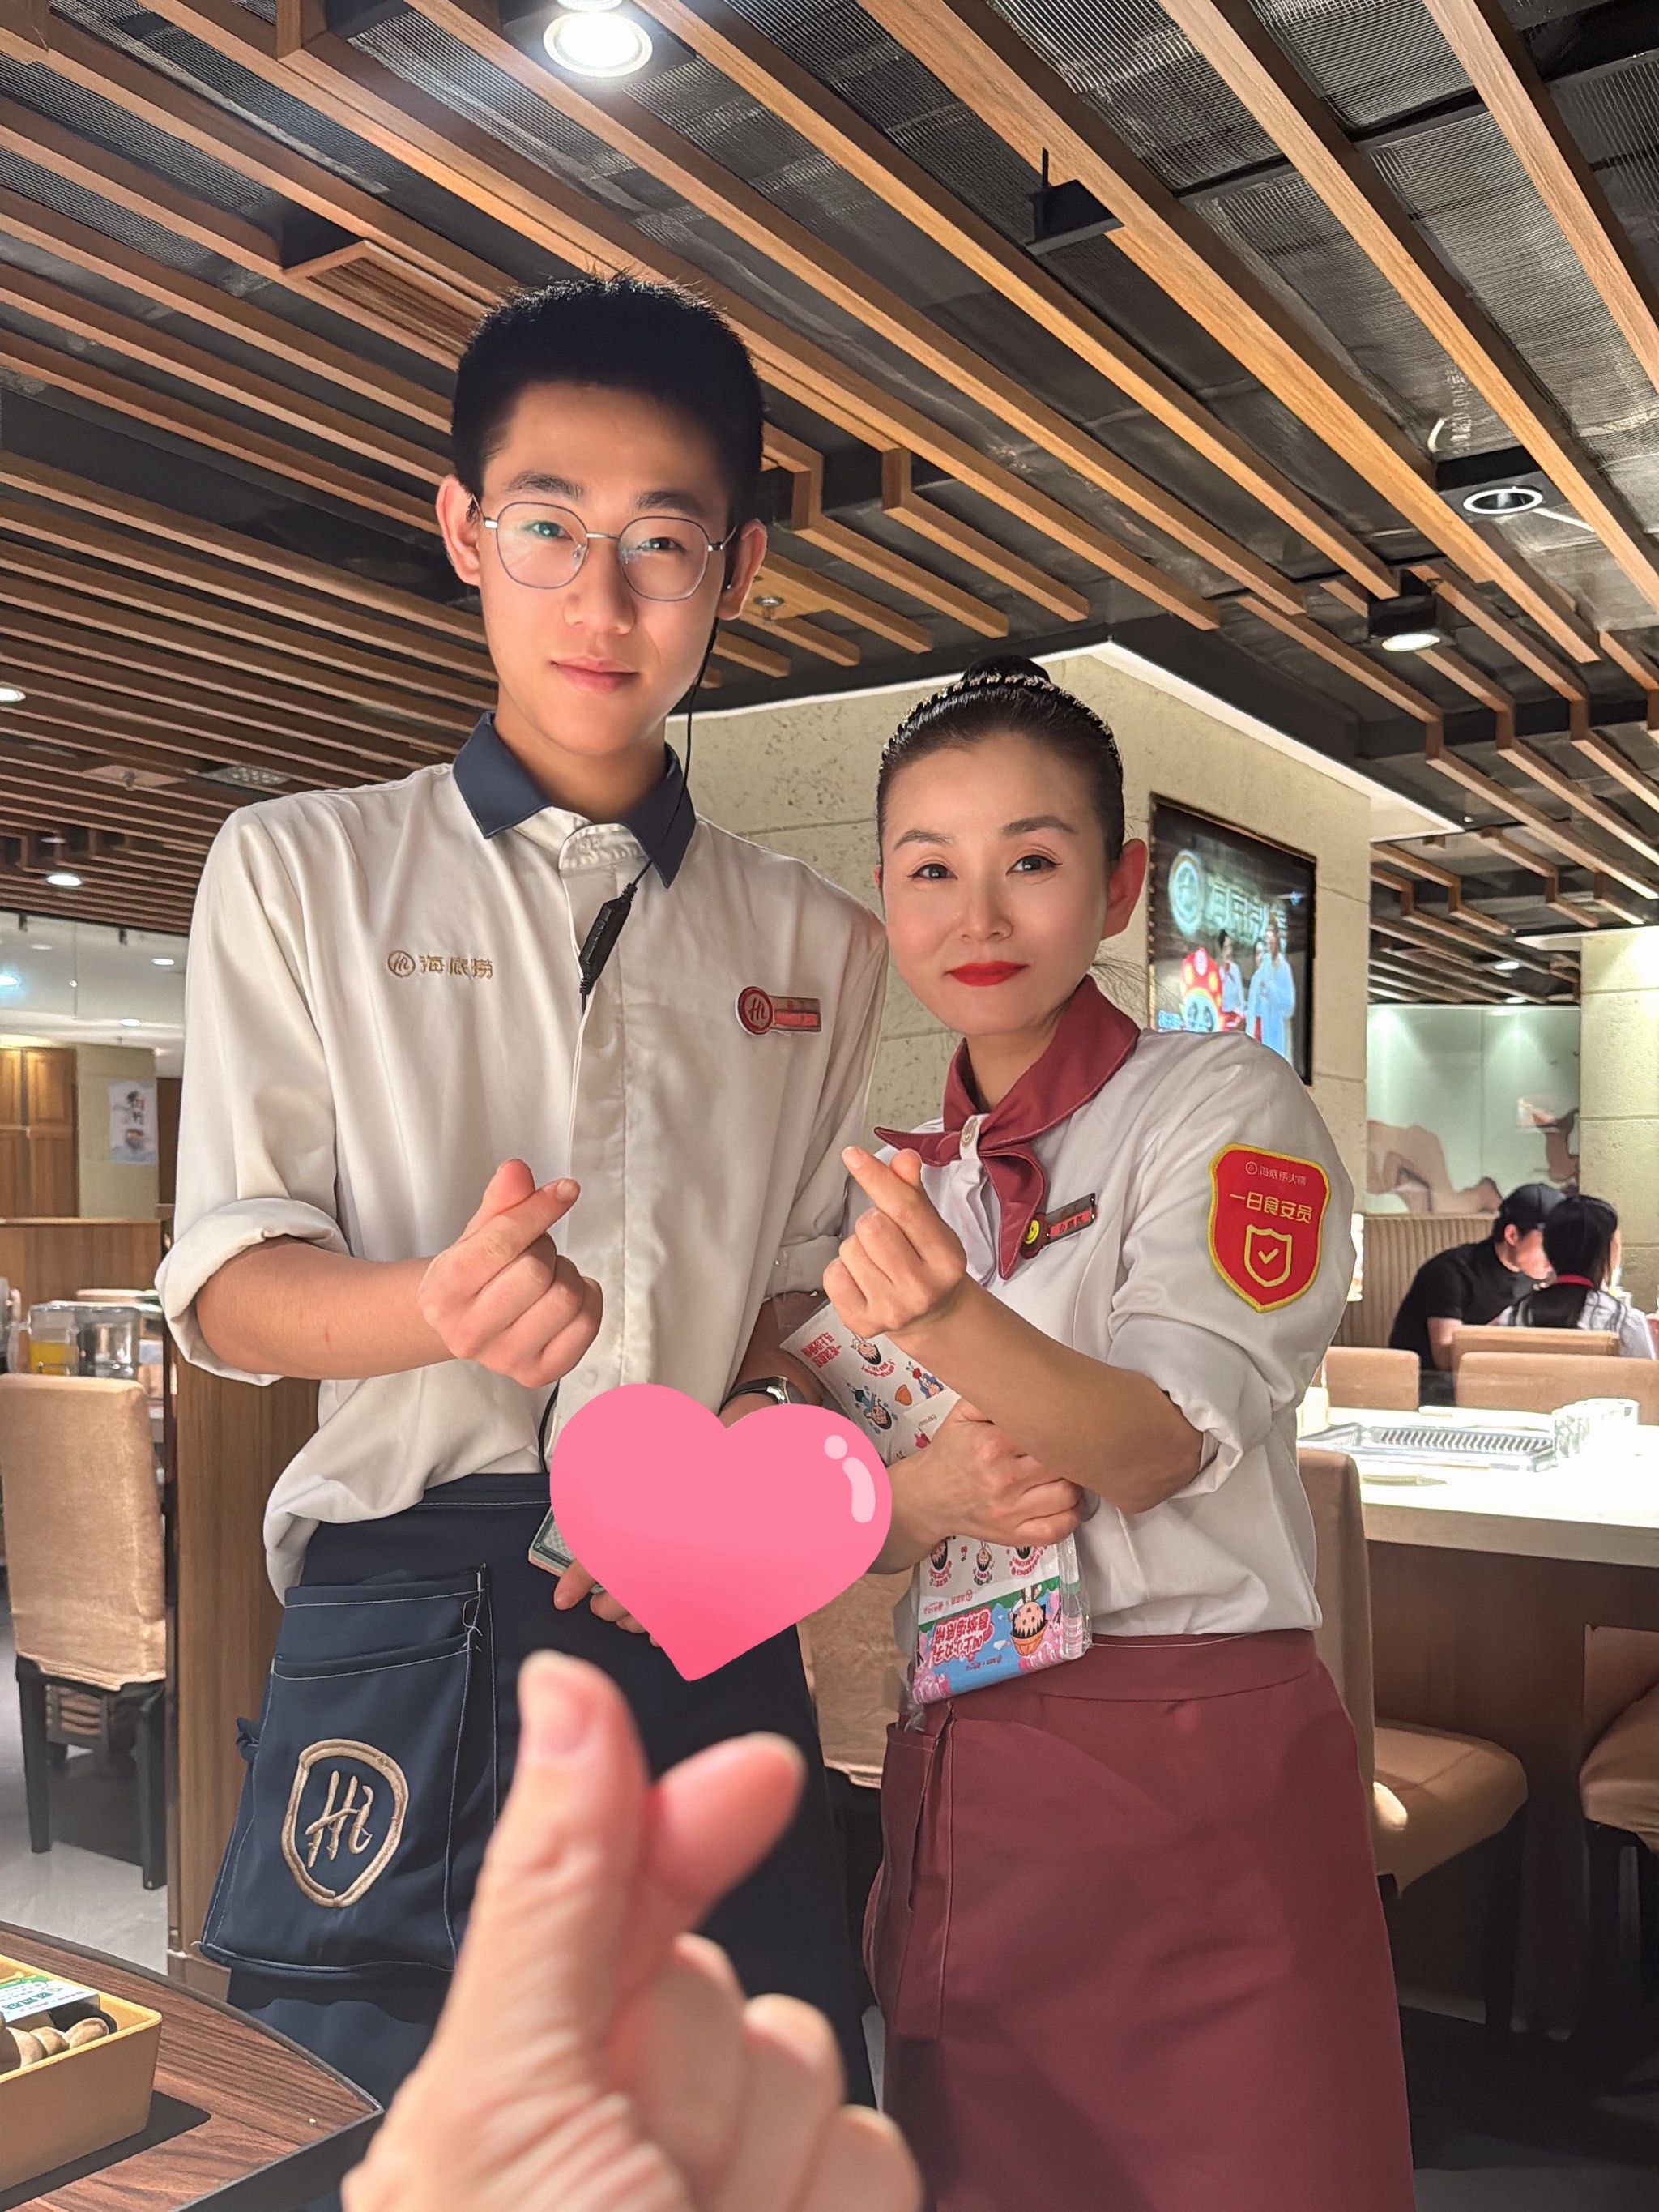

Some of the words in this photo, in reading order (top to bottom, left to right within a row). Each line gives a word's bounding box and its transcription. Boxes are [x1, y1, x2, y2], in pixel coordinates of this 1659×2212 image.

[419, 954, 493, 979] 海底捞
[1229, 1191, 1314, 1224] 一日食安员
